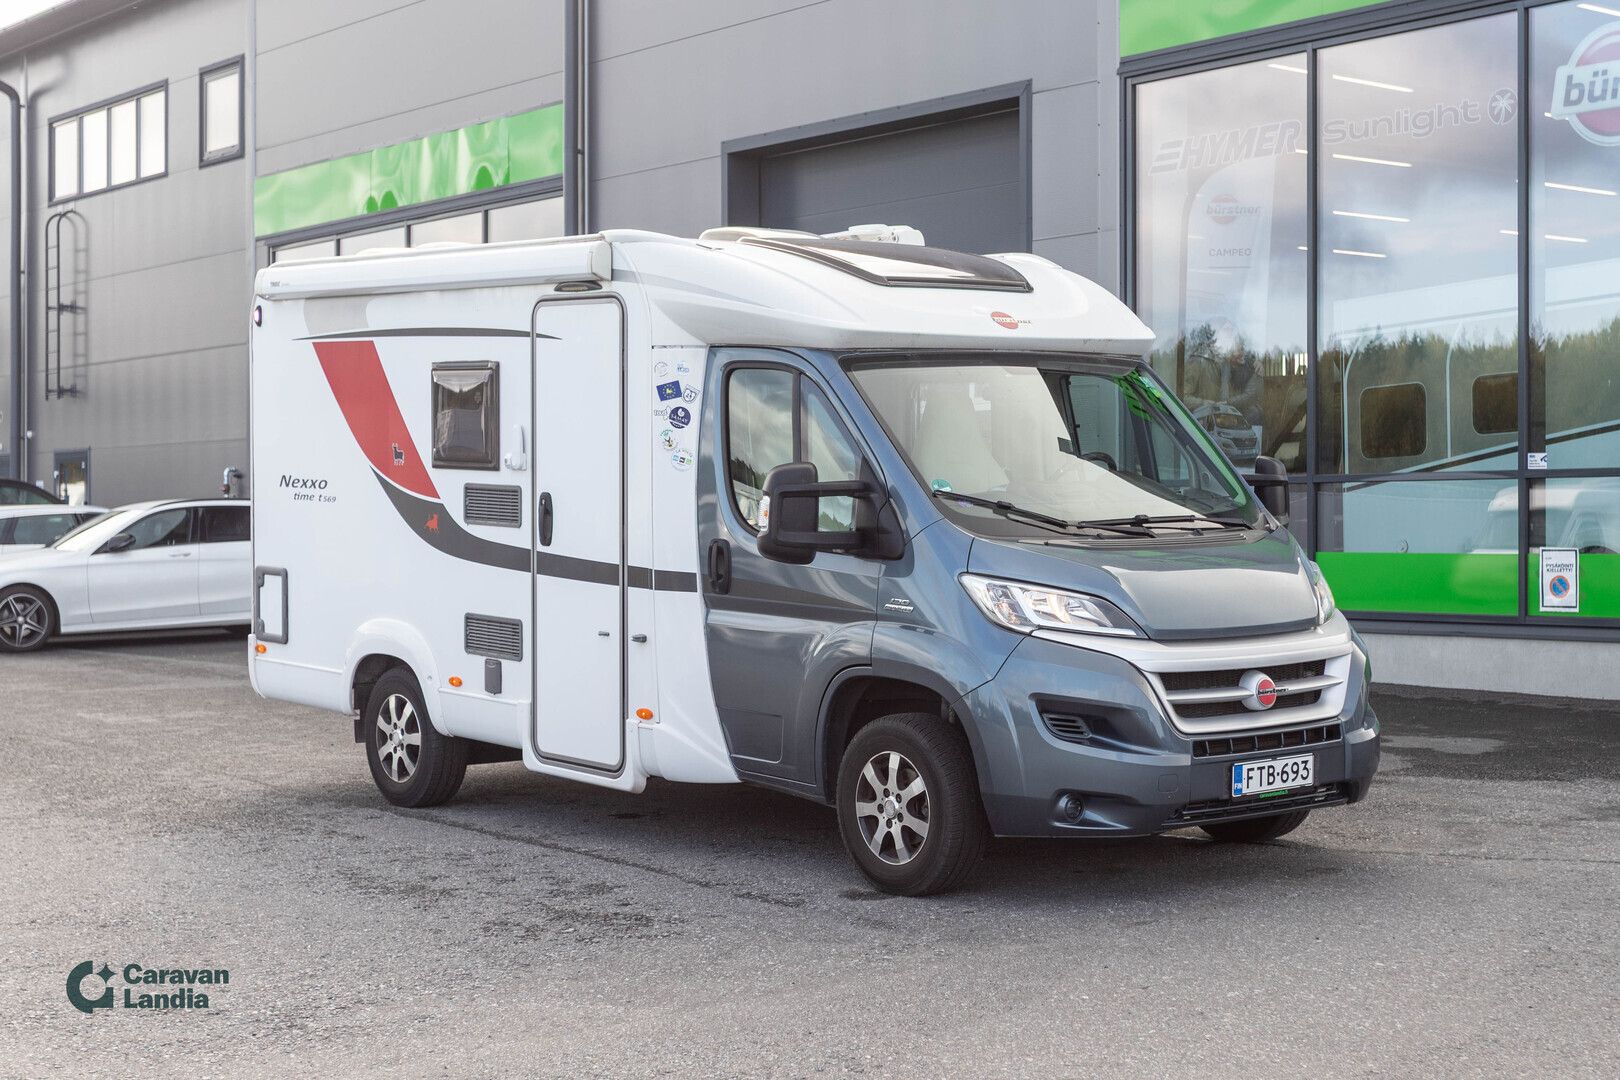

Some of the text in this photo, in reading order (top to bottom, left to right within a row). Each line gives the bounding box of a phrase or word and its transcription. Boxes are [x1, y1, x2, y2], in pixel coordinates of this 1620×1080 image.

[1179, 119, 1302, 170] HYMER
[1205, 203, 1261, 216] bürstner
[1208, 247, 1252, 257] CAMPEO
[280, 474, 328, 489] Nexxo
[293, 491, 315, 502] time
[1246, 759, 1310, 789] FTB-693
